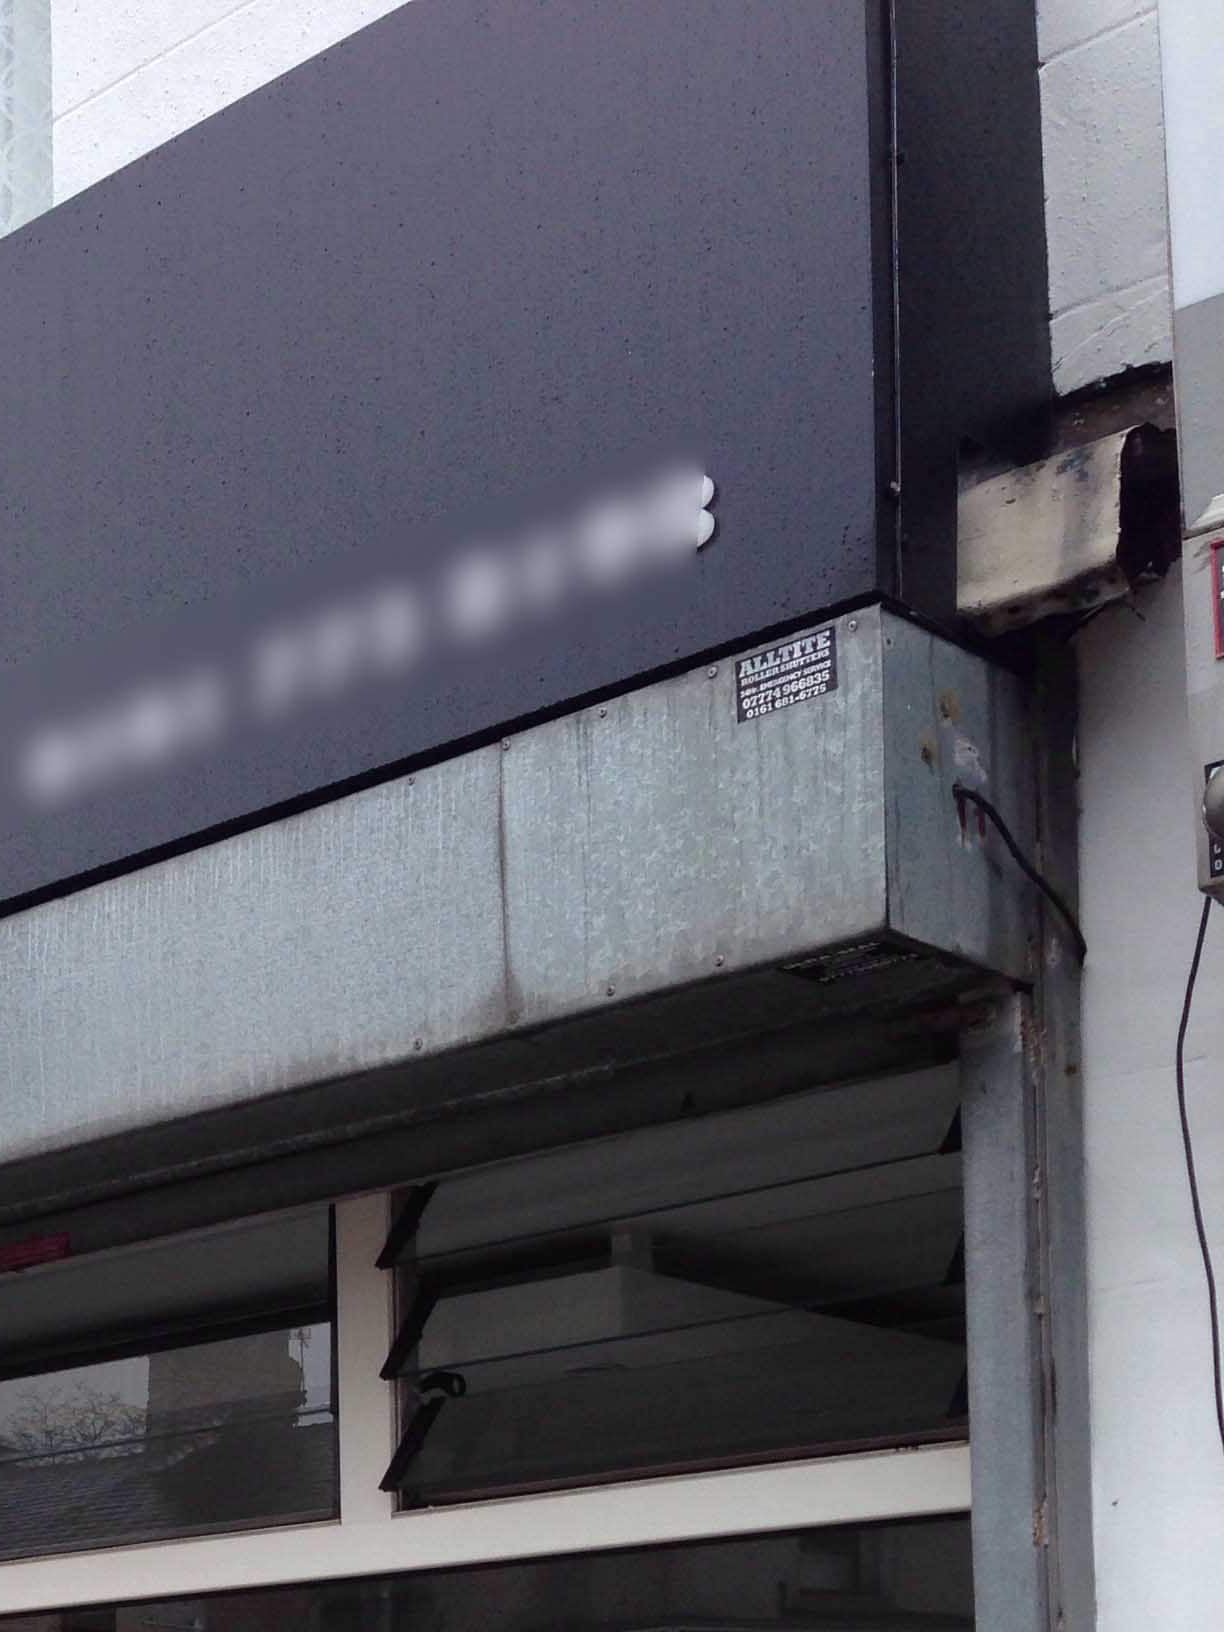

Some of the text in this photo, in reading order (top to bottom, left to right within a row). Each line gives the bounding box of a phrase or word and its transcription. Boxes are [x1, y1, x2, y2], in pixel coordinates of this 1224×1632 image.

[739, 630, 831, 678] ALLTITE
[741, 666, 779, 687] ROLLER
[742, 669, 830, 710] 07774 966835
[746, 702, 772, 718] 0161
